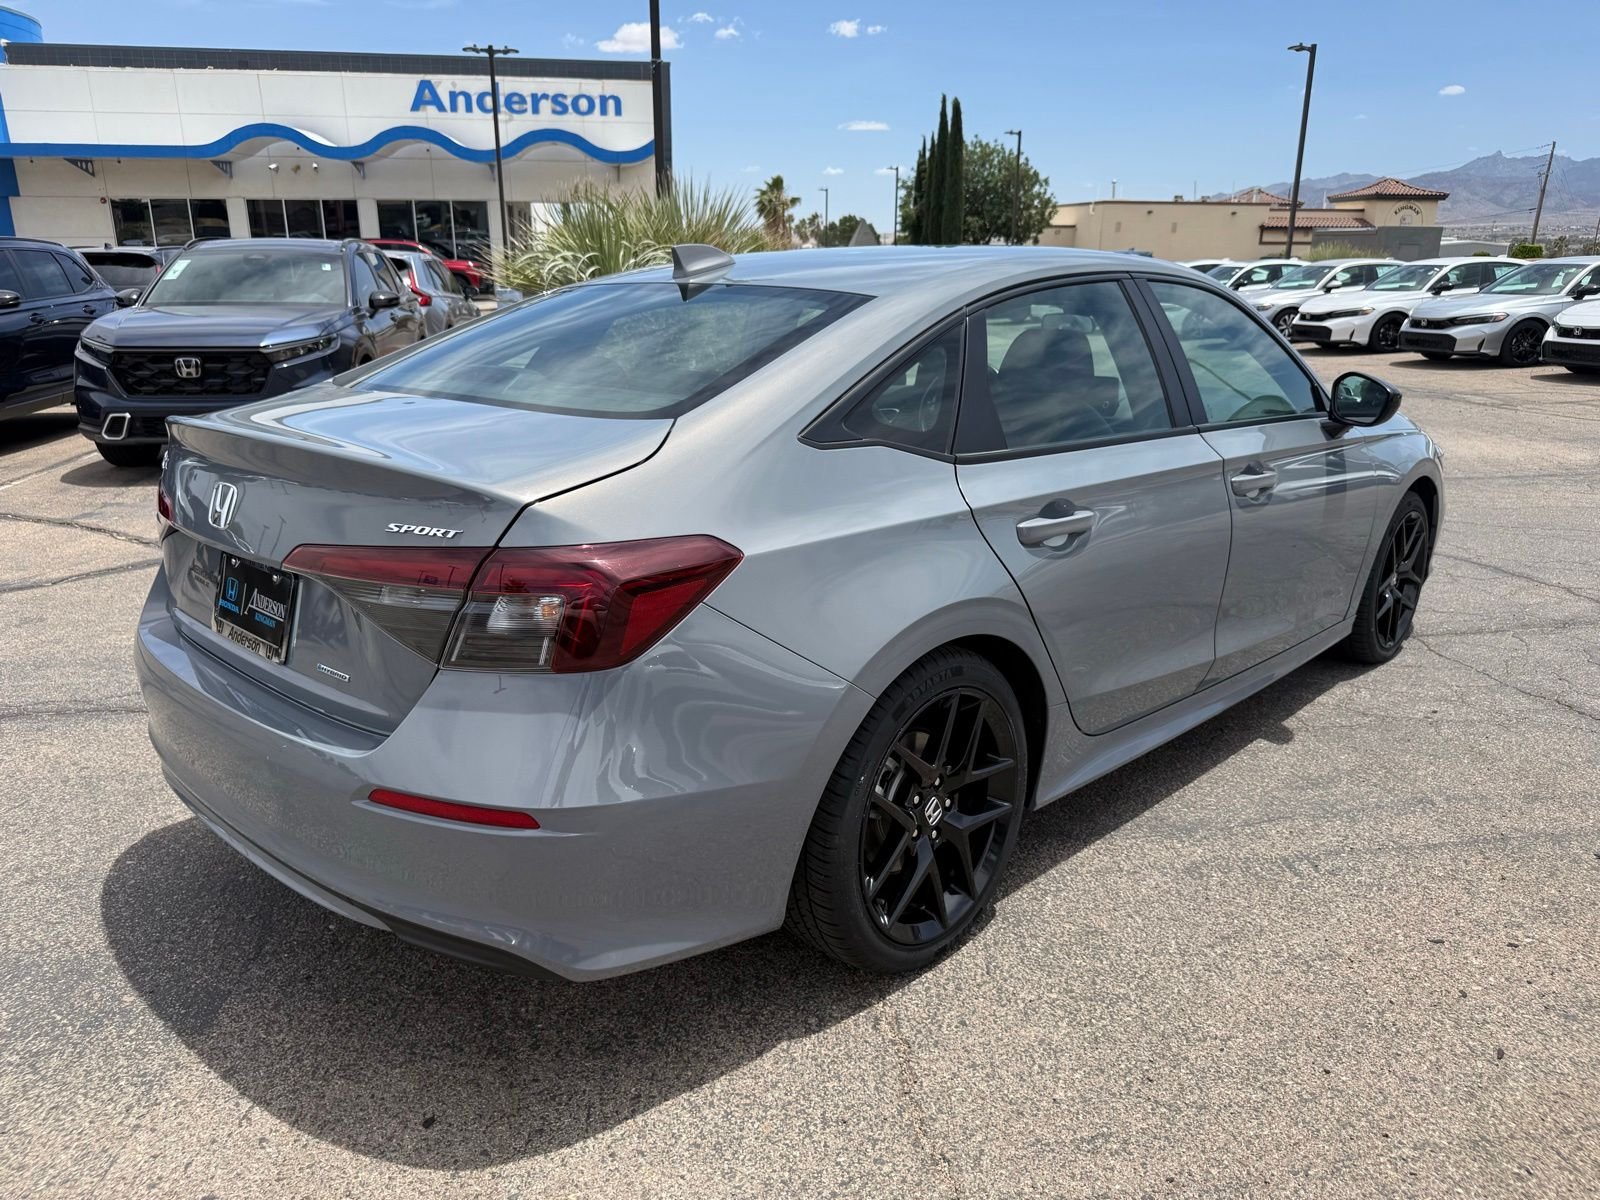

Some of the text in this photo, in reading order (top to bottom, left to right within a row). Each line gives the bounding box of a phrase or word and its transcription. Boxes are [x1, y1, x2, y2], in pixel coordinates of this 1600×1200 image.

[410, 79, 622, 117] Anderson
[1394, 204, 1420, 215] KINGMAN
[384, 523, 464, 539] SPORT
[219, 598, 240, 614] HONDA
[244, 588, 286, 619] ANDERSON
[228, 626, 261, 653] Anderson
